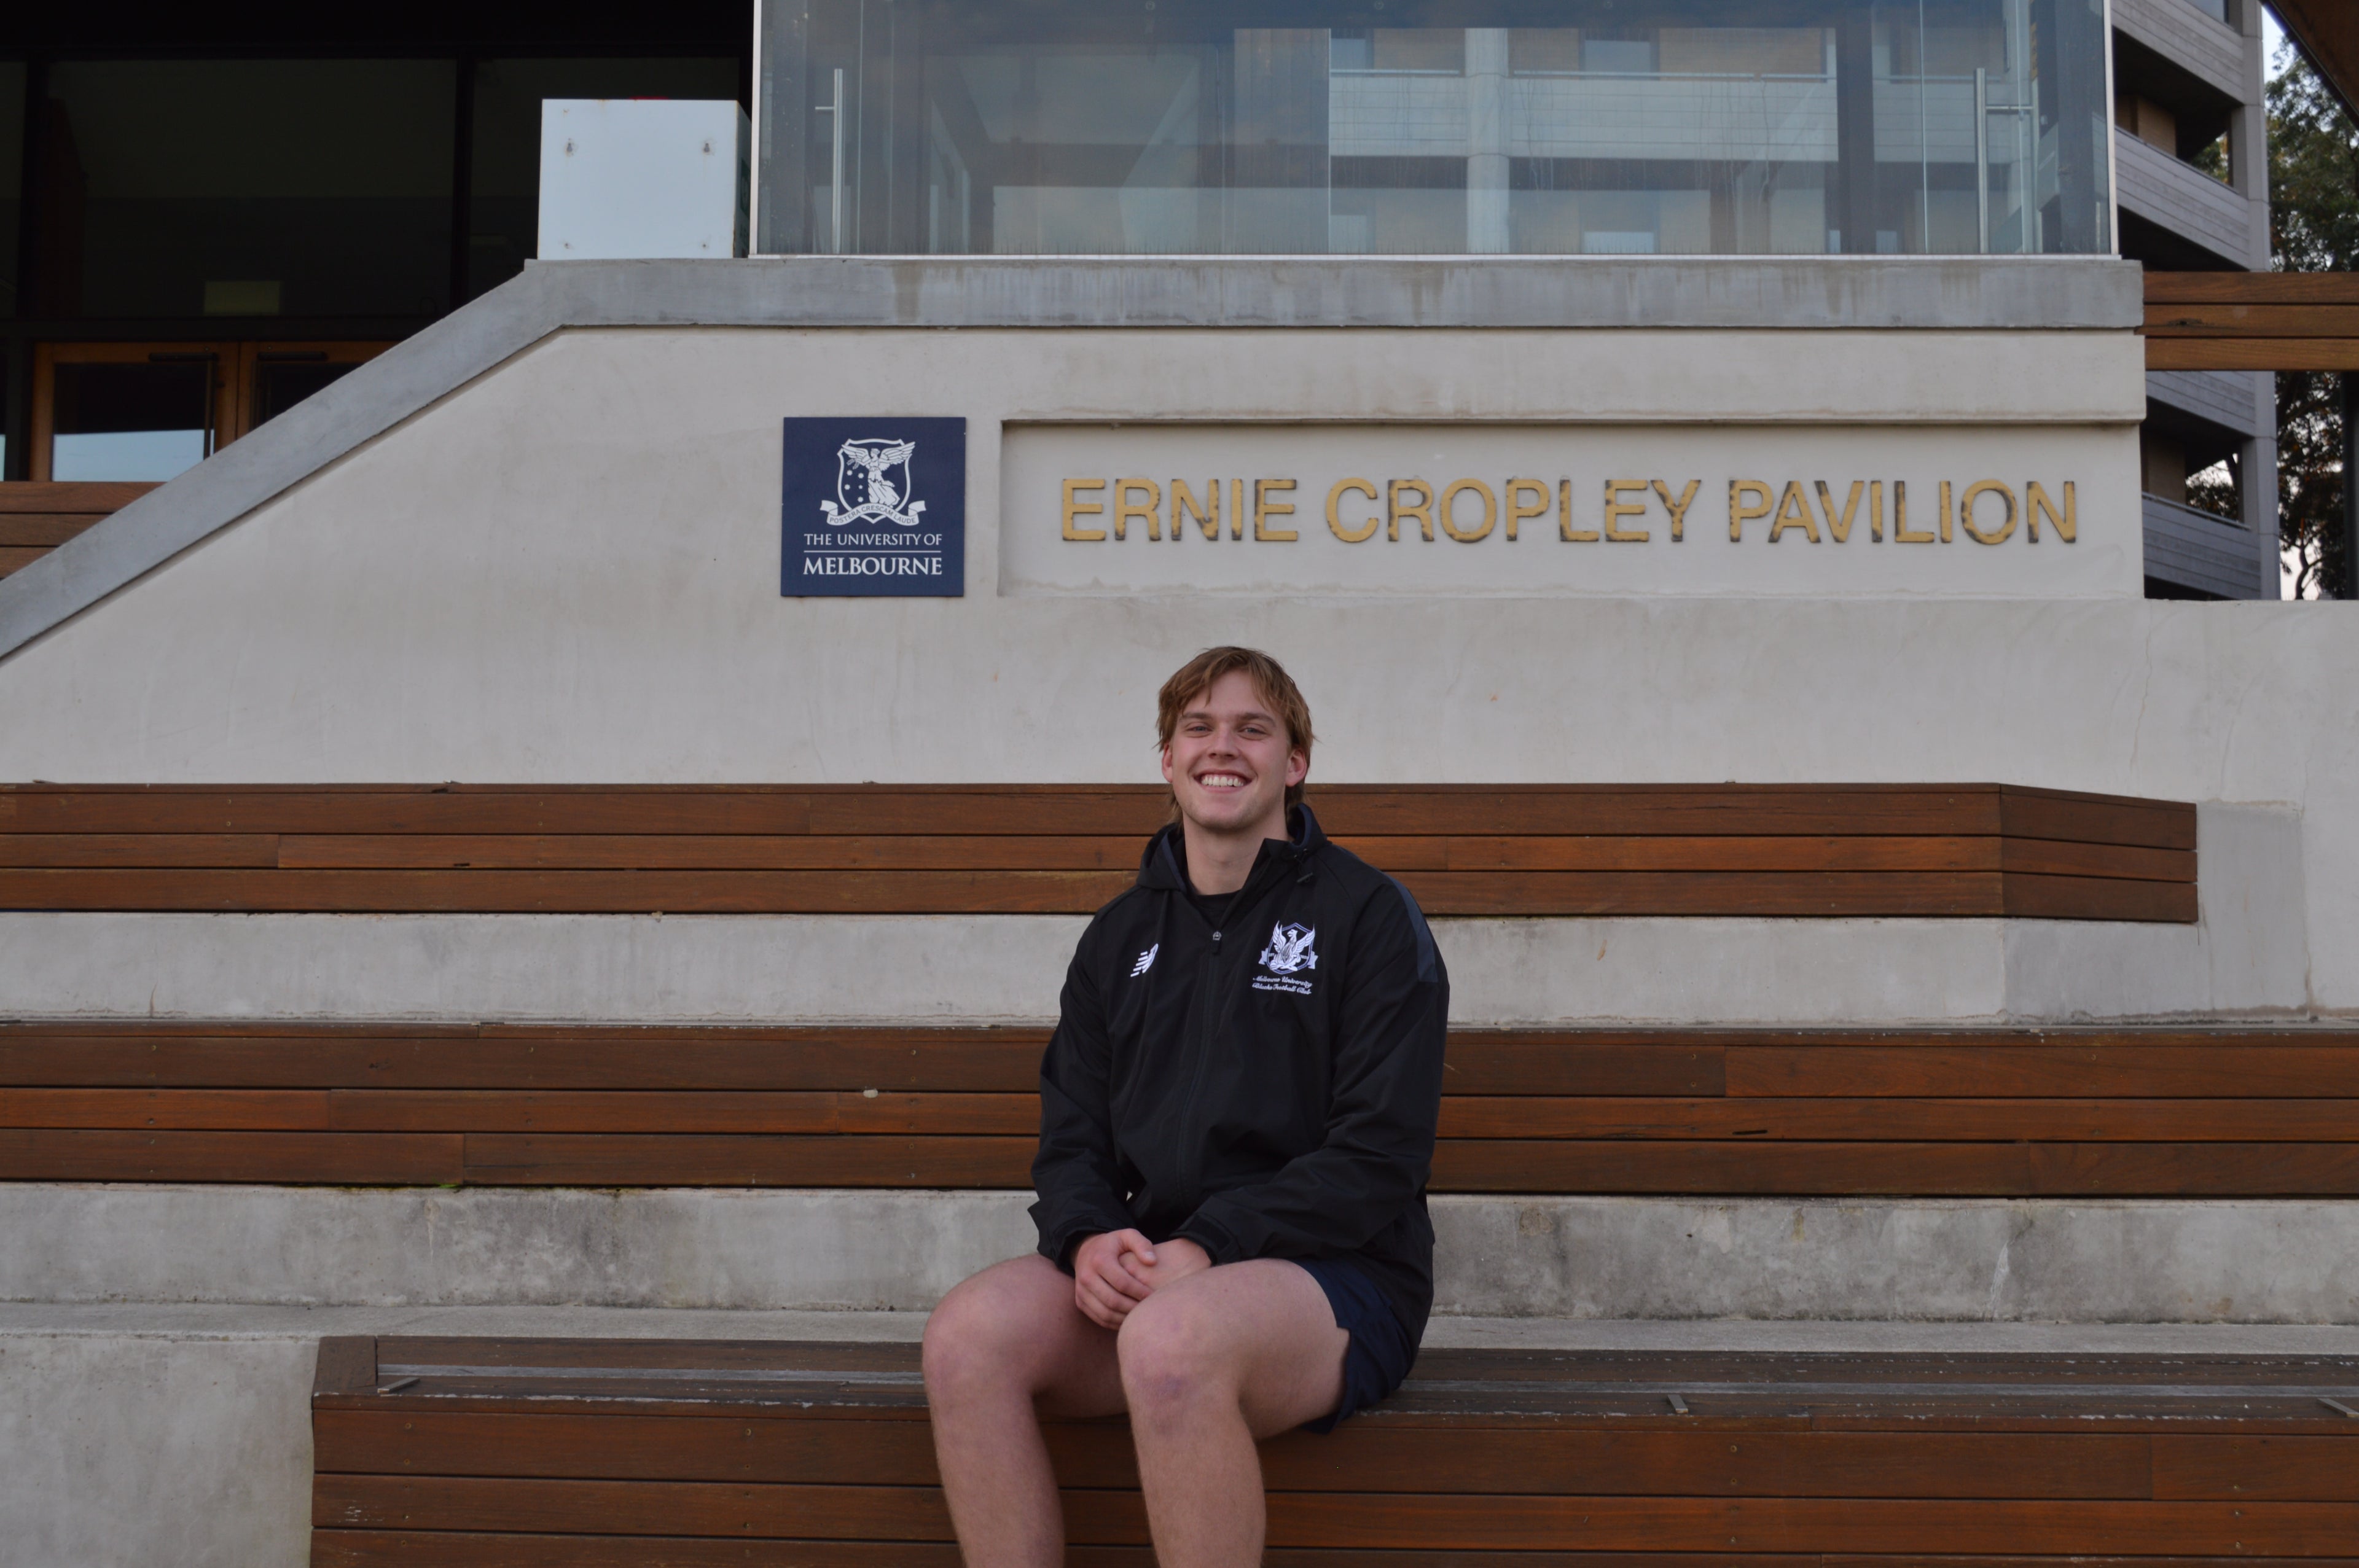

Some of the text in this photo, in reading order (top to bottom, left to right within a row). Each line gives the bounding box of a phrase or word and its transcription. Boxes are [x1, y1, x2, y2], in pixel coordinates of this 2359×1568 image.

[829, 505, 917, 524] POSTERA CRESCAM LAUDE
[1062, 477, 2076, 545] ERNIE CROPLEY PAVILION
[804, 533, 942, 545] THE UNIVERSITY OF
[803, 556, 943, 575] MELBOURNE
[1281, 976, 1312, 988] University
